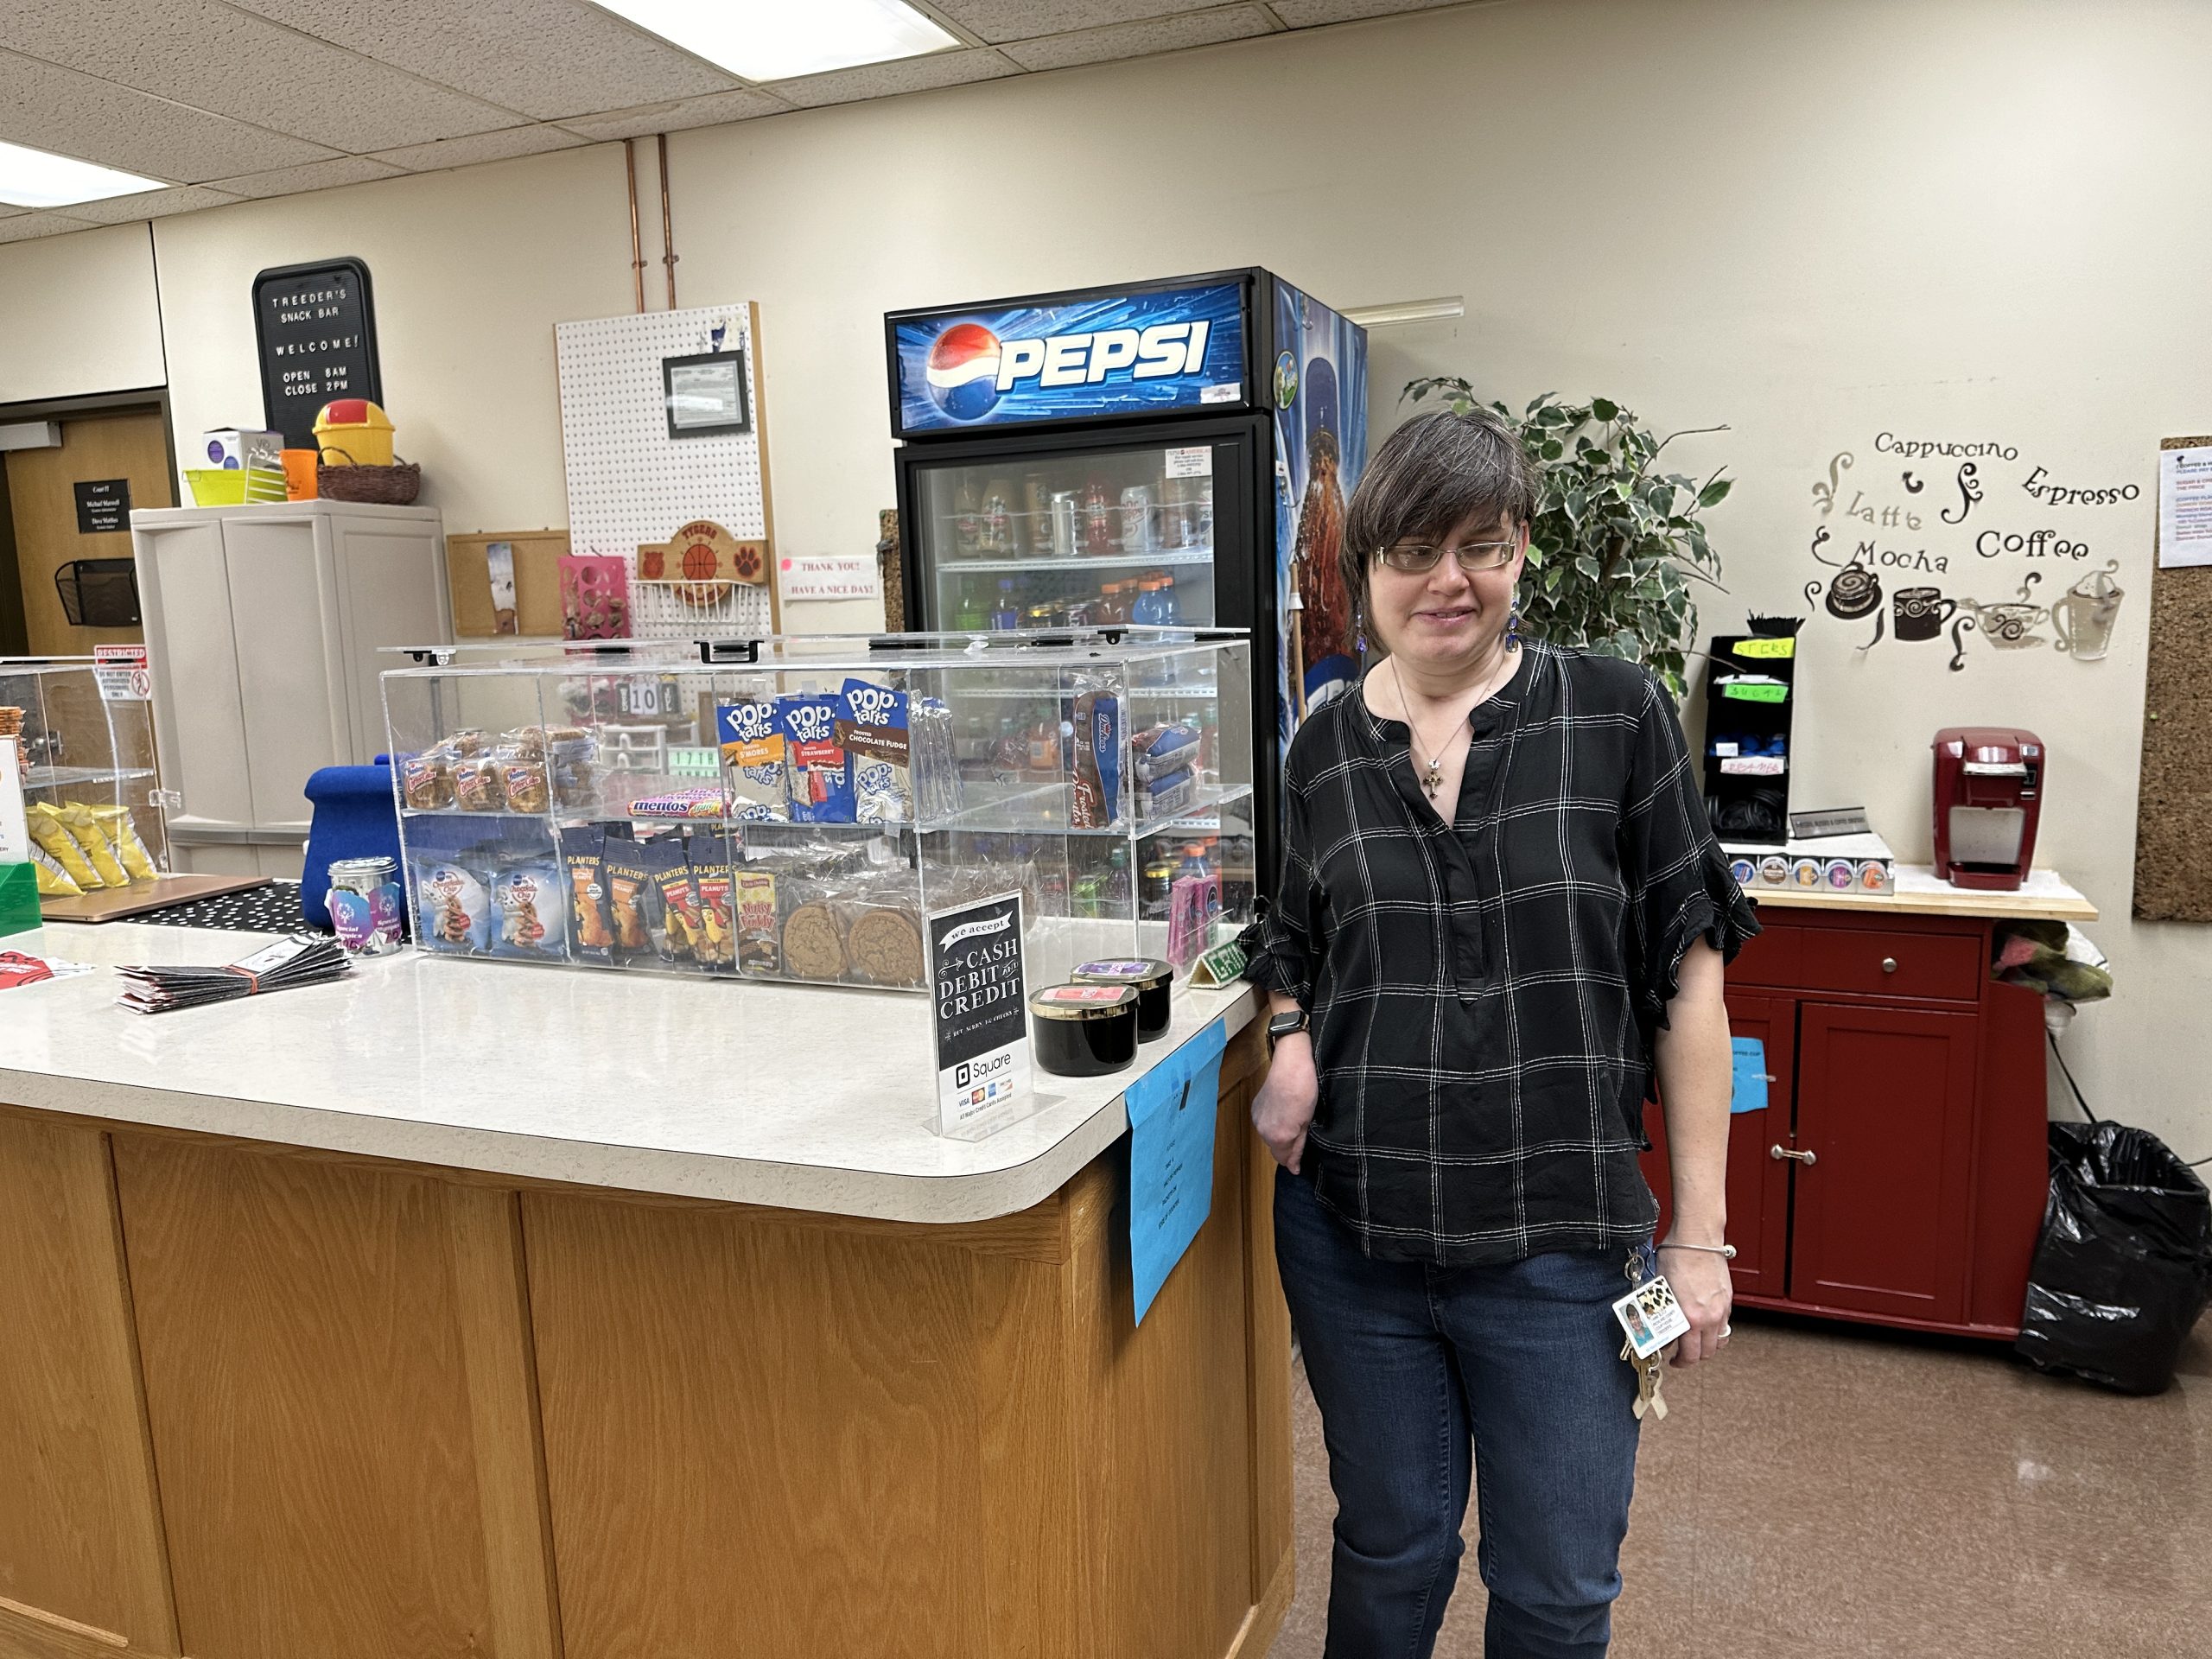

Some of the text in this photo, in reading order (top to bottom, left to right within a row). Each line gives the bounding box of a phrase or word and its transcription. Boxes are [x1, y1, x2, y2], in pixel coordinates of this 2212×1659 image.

[272, 289, 346, 308] TREEDER'S
[281, 307, 339, 324] SNACK BAR
[276, 335, 359, 356] WELCOME!
[995, 321, 1210, 391] PEPSI
[283, 367, 346, 383] OPEN 8AM
[284, 380, 348, 397] CLOSE 2PM
[1874, 432, 2018, 461] Cappuccino
[1846, 491, 1922, 531] Latte
[1977, 530, 2089, 560] Coffee
[1853, 540, 1949, 574] Mocha
[802, 563, 860, 571] THANK YOU!
[791, 586, 816, 594] HAVE
[851, 585, 873, 594] DAY!
[632, 690, 655, 709] 10
[849, 734, 907, 750] CHOCOLATE FUDGE
[740, 747, 769, 759] S'MORES
[633, 801, 688, 811] mentos
[568, 856, 600, 866] PLANTERS
[607, 865, 649, 881] PLANTERS
[654, 866, 690, 883] PLANTERS
[666, 887, 690, 897] PEANUTS
[951, 920, 1004, 939] we accept
[967, 938, 1018, 969] CASH
[939, 962, 1018, 1000] DEBIT AND
[940, 977, 1020, 1020] CREDIT
[973, 1053, 1011, 1077] Square
[959, 1097, 969, 1107] VISA
